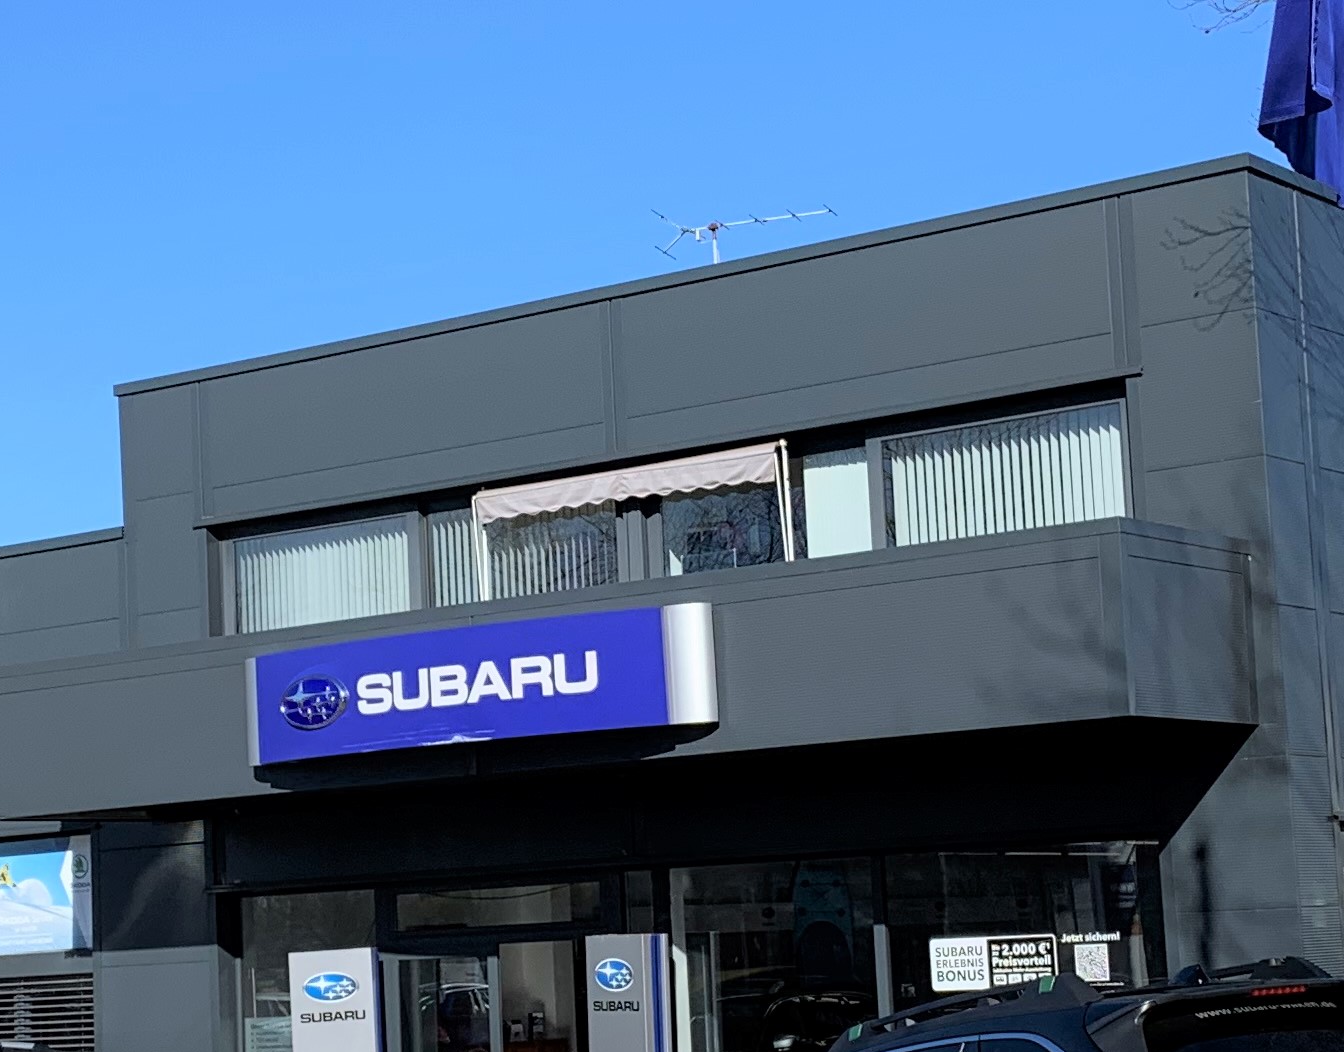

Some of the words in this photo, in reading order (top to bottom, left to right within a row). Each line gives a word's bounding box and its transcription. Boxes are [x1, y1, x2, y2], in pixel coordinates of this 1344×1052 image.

[357, 650, 599, 715] SUBARU
[1061, 933, 1083, 943] Jetzt
[1085, 930, 1121, 942] sichern!
[935, 945, 983, 957] SUBARU
[1001, 943, 1036, 956] 2.000
[936, 957, 984, 969] ERLEBNIS
[992, 954, 1051, 967] Preisvorteil
[937, 970, 985, 982] BONUS
[593, 1001, 640, 1012] SUBARU
[300, 1010, 366, 1024] SUBARU
